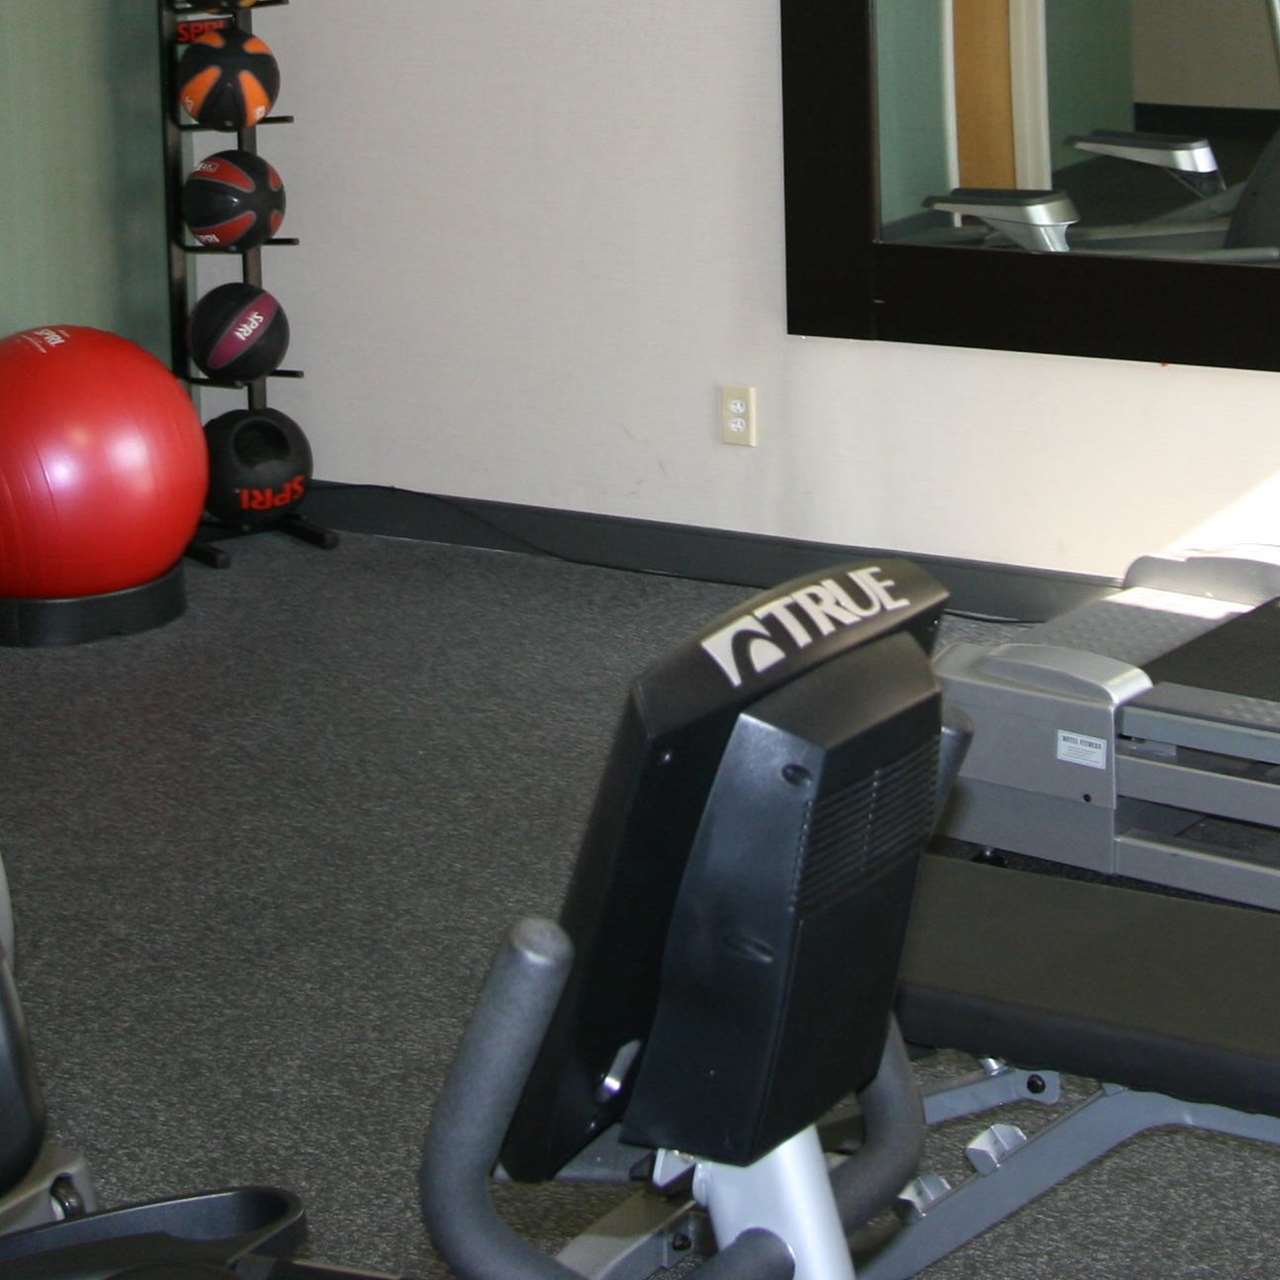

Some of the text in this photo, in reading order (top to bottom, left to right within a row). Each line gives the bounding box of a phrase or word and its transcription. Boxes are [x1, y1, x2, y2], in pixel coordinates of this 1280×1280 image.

[233, 311, 264, 341] SPRI
[239, 473, 305, 511] SPRI
[754, 566, 911, 649] TRUE
